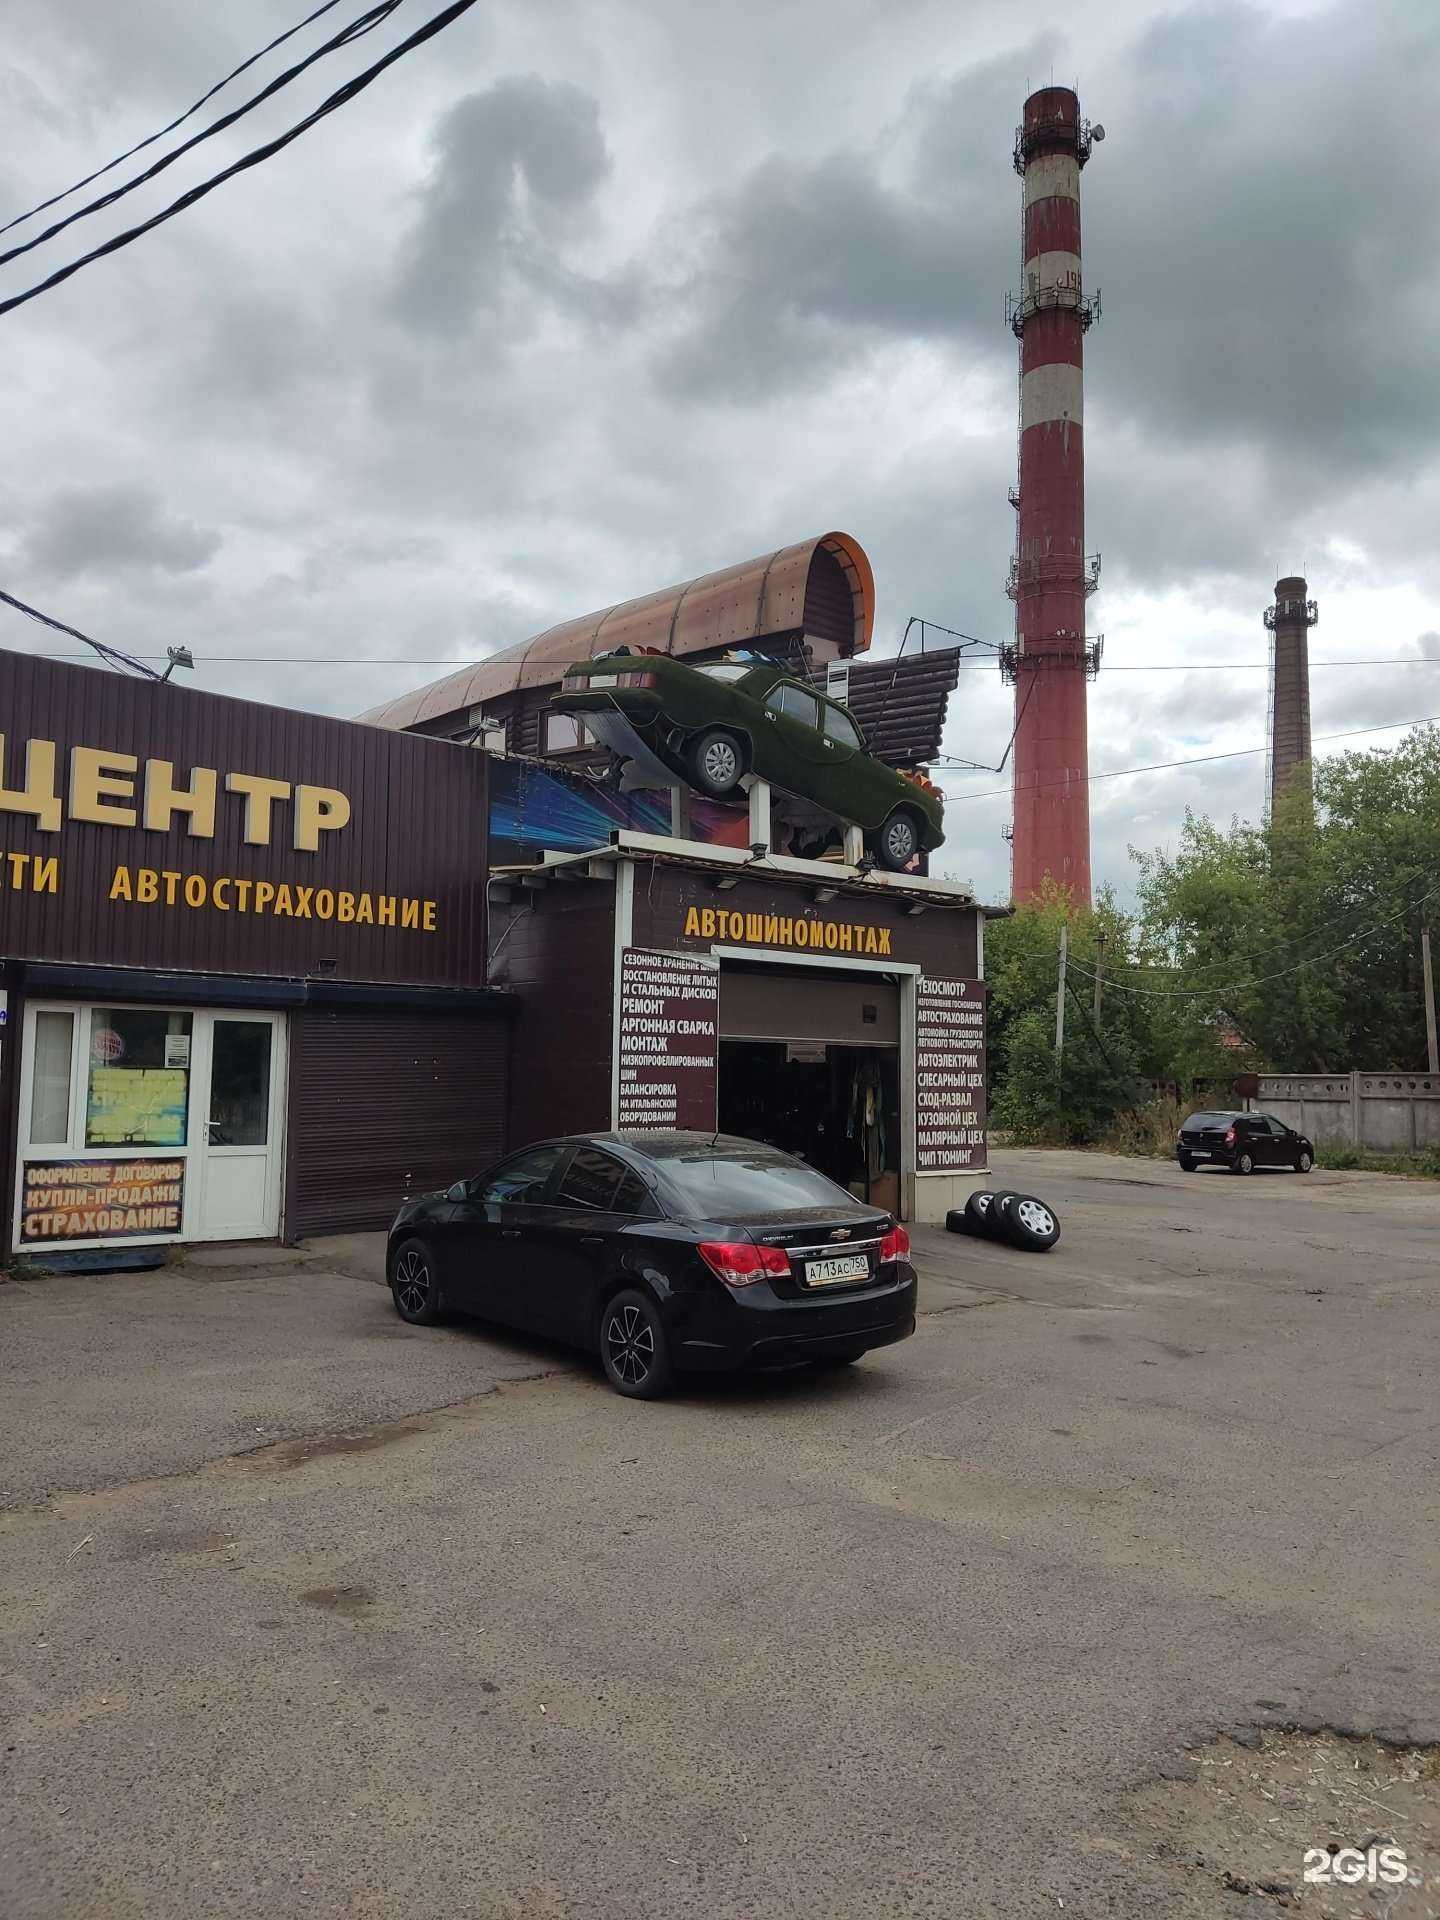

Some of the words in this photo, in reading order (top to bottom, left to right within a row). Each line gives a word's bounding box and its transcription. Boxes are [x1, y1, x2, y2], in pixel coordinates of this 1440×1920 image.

[0, 851, 58, 893] ТИ
[109, 866, 437, 931] АВТОСТРАХОВАНИЕ
[684, 906, 892, 955] АВТОШИНОМОНТАЖ
[624, 954, 662, 967] СЕЗОННОЕ
[663, 957, 699, 970] ХРАНЕНИЕ
[623, 969, 691, 985] ВОССТАНОВЛЕНИЕ
[692, 975, 717, 987] ЛИТЫХ
[623, 983, 630, 994] И
[631, 984, 680, 997] СТАЛЬНЫХ
[681, 987, 717, 1000] ДИСКОВ
[622, 998, 665, 1014] РЕМОНТ
[918, 1010, 983, 1025] АВТОСТРАХОВАНИЕ
[622, 1018, 676, 1034] АРГОННАЯ
[677, 1020, 715, 1035] СВАРКА
[918, 1027, 949, 1038] АВТОМОЙКА
[949, 1029, 979, 1039] ГРУЗОВОГО
[621, 1036, 668, 1051] МОНТАЖ
[917, 1038, 948, 1049] ЛЕГКОВОГО
[949, 1040, 983, 1050] ТРАНСПОРТА
[918, 1053, 978, 1068] АВТОЭЛЕКТРИК
[620, 1069, 637, 1080] ШИН
[918, 1071, 967, 1087] СЛЕСАРНЫЙ
[967, 1074, 983, 1089] ЦЕХ
[620, 1084, 677, 1095] БАЛАНСИРОВКА
[620, 1099, 628, 1108] НА
[630, 1099, 677, 1108] ИТАЛЬЯНСКОМ
[918, 1093, 972, 1109] СХОД-РАЗВАЛ
[620, 1112, 677, 1124] ОБОРУДОВАНИИ
[918, 1109, 961, 1126] КУЗОВНОЙ
[962, 1112, 978, 1128] ЦЕХ
[918, 1128, 967, 1145] МАЛЯРНЫЙ
[967, 1130, 984, 1147] ЦЕХ
[918, 1151, 936, 1165] ЧИП
[937, 1150, 972, 1165] ТЮНИНГ
[27, 1166, 111, 1185] ОФОРМЛЕНИЕ
[113, 1163, 182, 1183] ДОГОВОРОВ
[26, 1184, 180, 1208] КУПЛИ-ПРОДАЖИ
[25, 1206, 179, 1236] СТРАХОВАНИЕ
